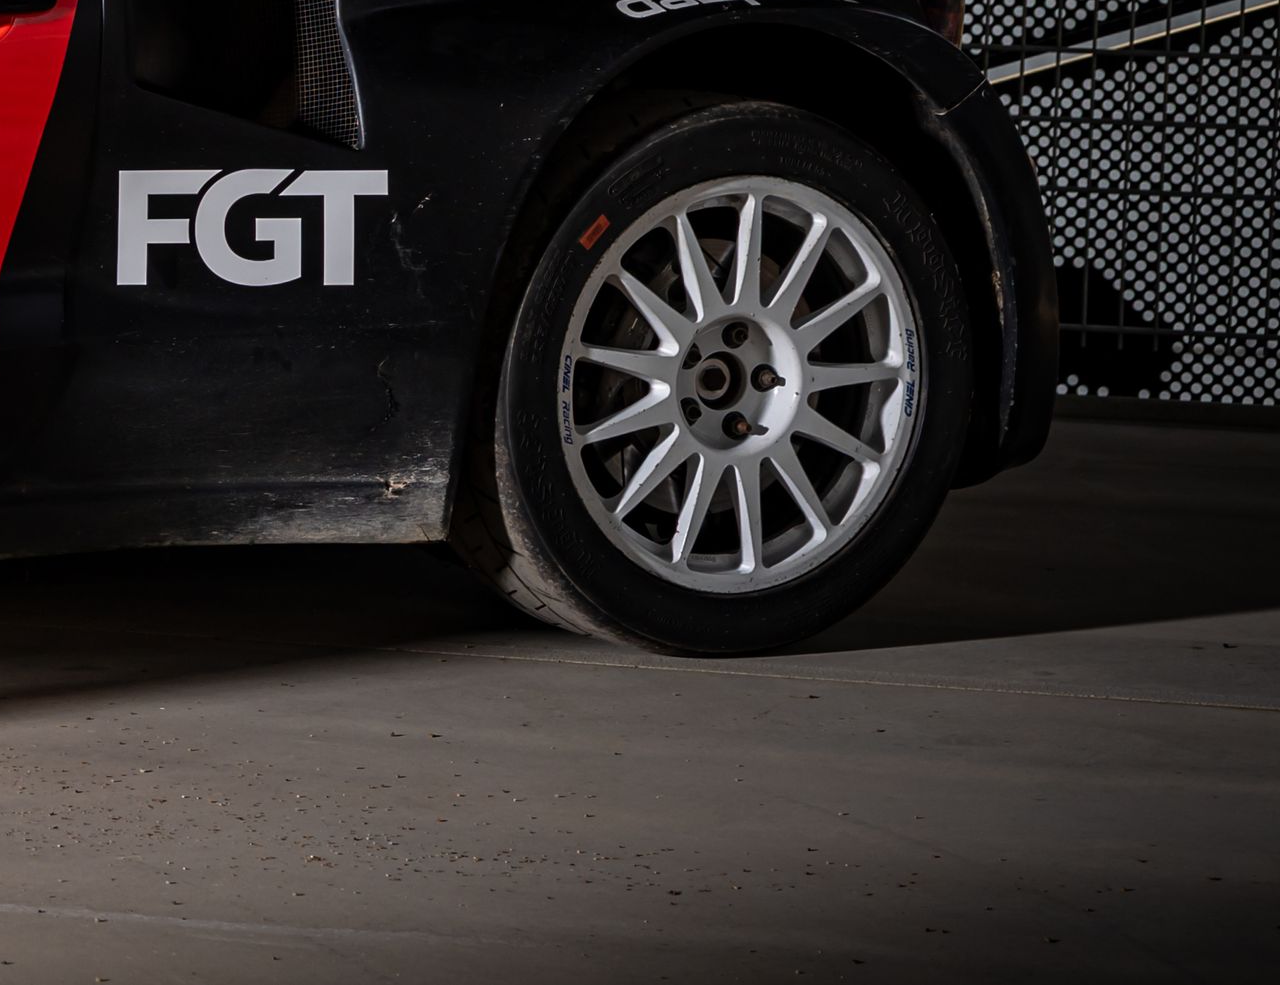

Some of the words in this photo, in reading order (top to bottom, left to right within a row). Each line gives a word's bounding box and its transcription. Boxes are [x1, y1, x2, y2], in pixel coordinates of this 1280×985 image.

[117, 169, 388, 286] FGT
[904, 329, 917, 373] Racing
[563, 354, 575, 394] CINEL
[903, 379, 917, 418] CINEL
[562, 400, 574, 446] Racing
